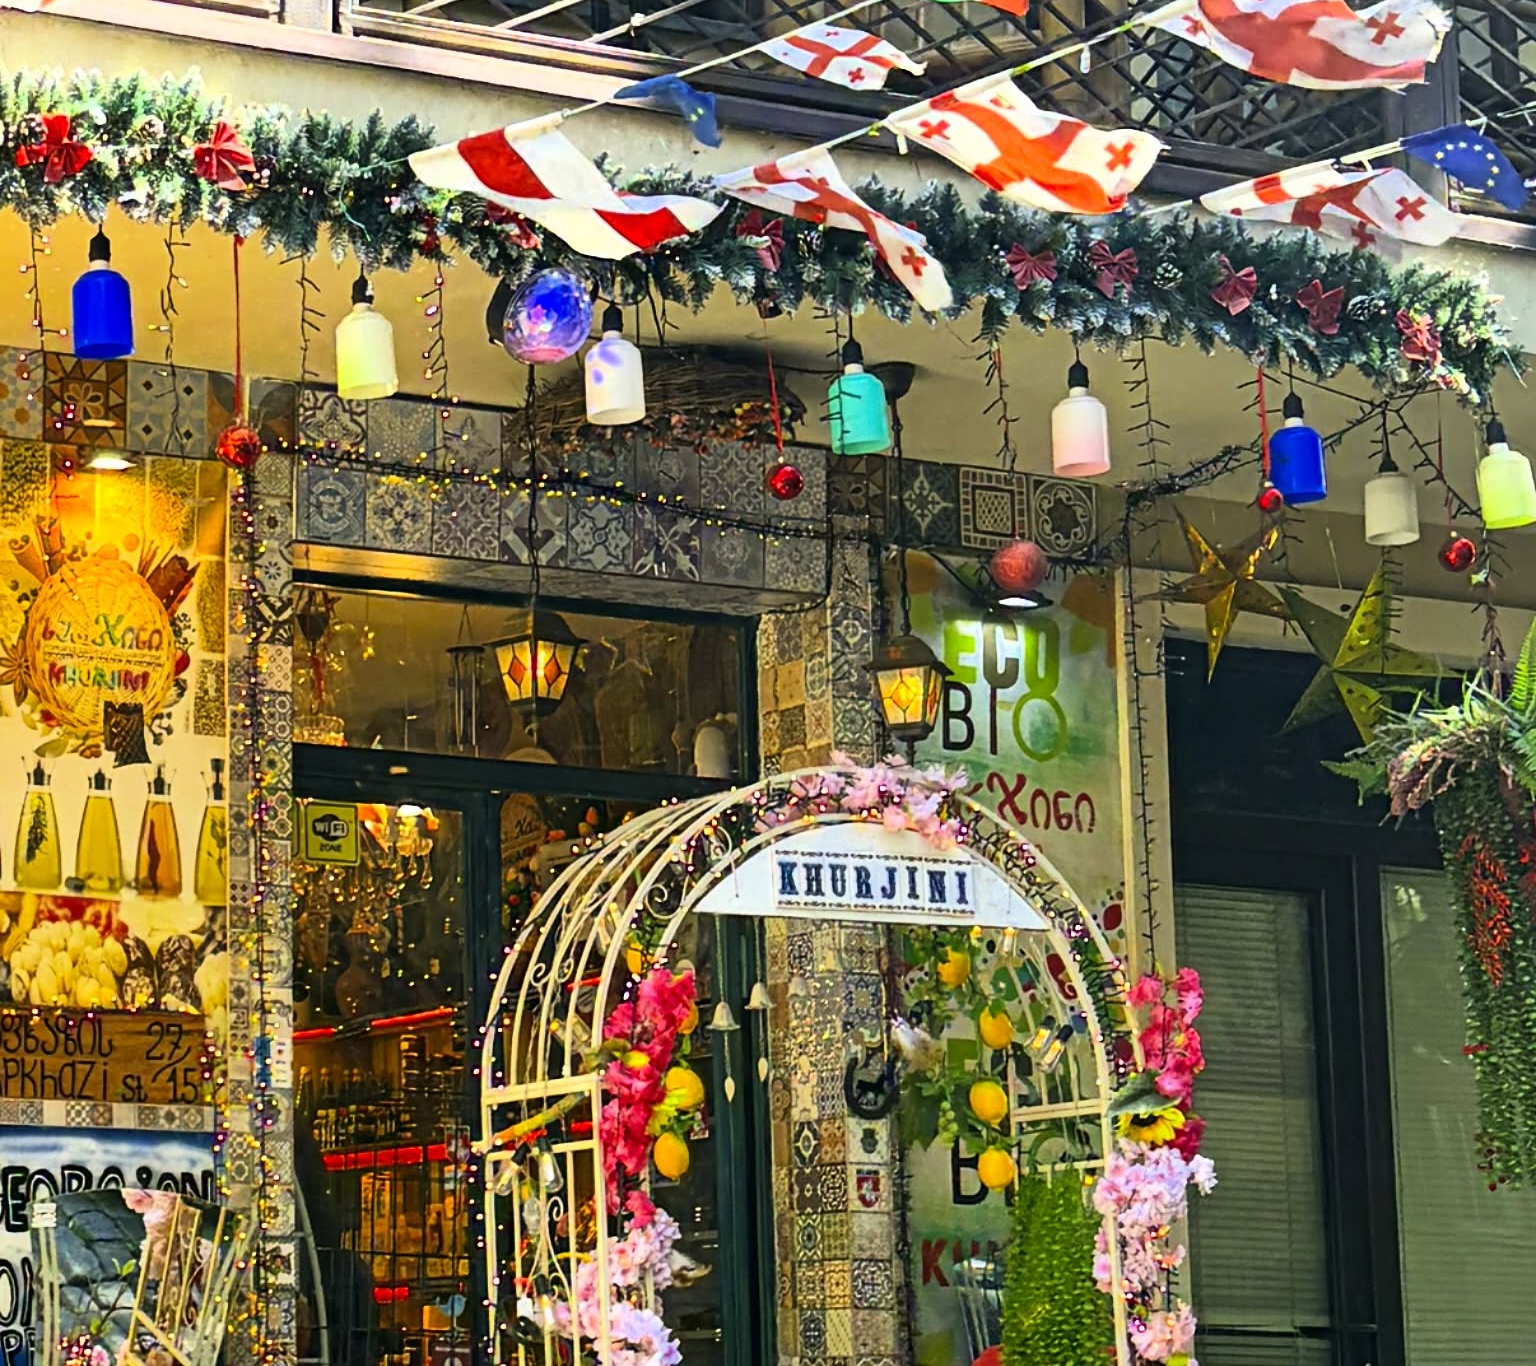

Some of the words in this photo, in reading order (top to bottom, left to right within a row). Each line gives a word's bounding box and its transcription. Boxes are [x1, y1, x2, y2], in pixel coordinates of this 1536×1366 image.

[942, 613, 1060, 693] ECO
[942, 681, 1067, 763] BIO
[319, 843, 343, 852] ZONE
[777, 861, 969, 905] KHURJINI
